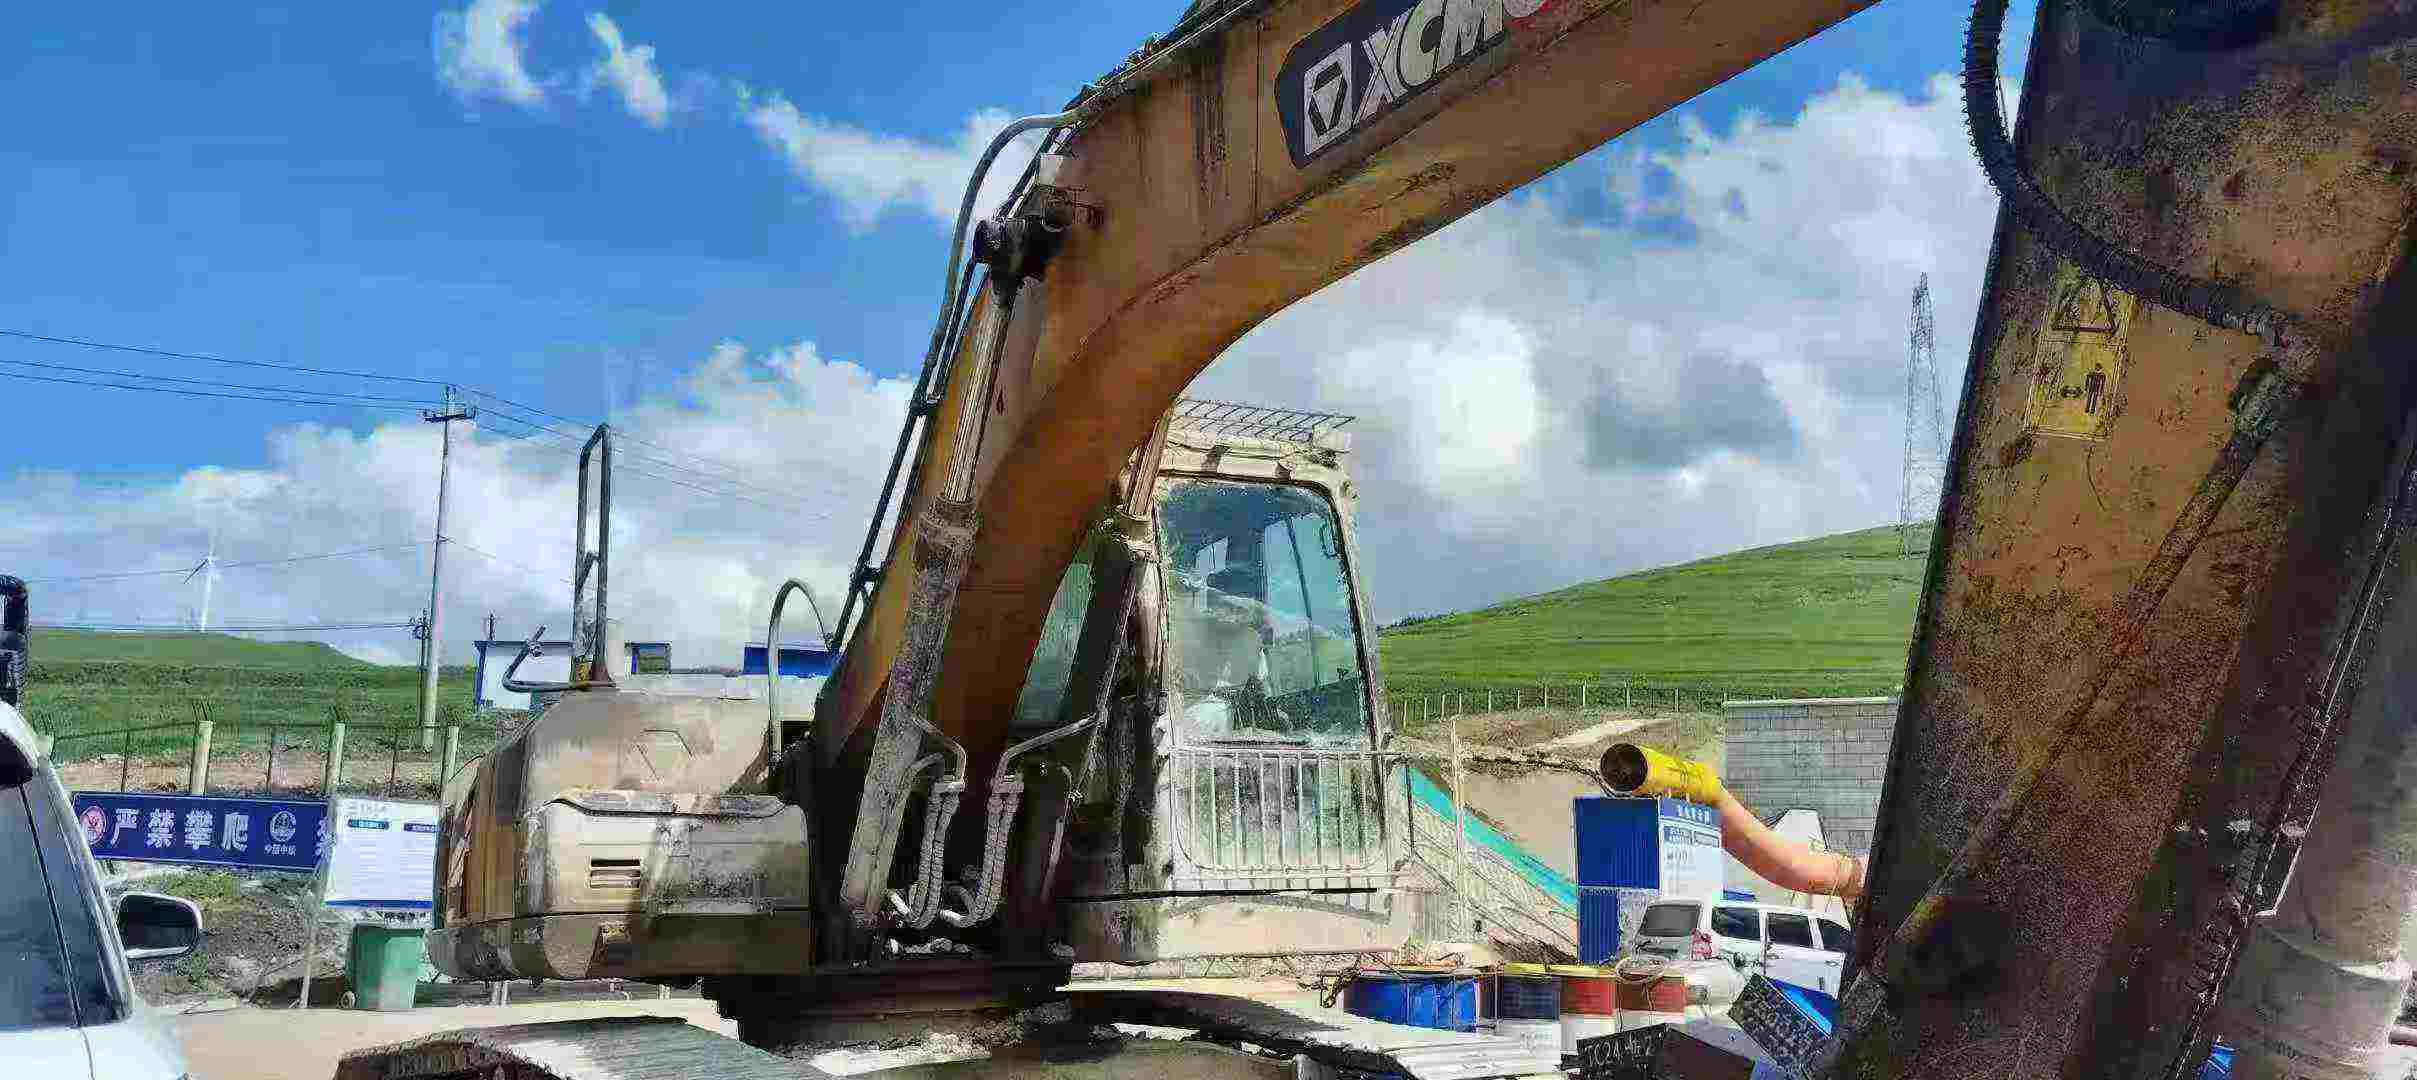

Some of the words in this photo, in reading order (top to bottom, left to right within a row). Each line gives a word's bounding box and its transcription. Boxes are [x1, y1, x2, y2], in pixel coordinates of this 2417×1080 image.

[1352, 0, 1549, 127] XCM
[110, 808, 249, 850] 严禁攀爬
